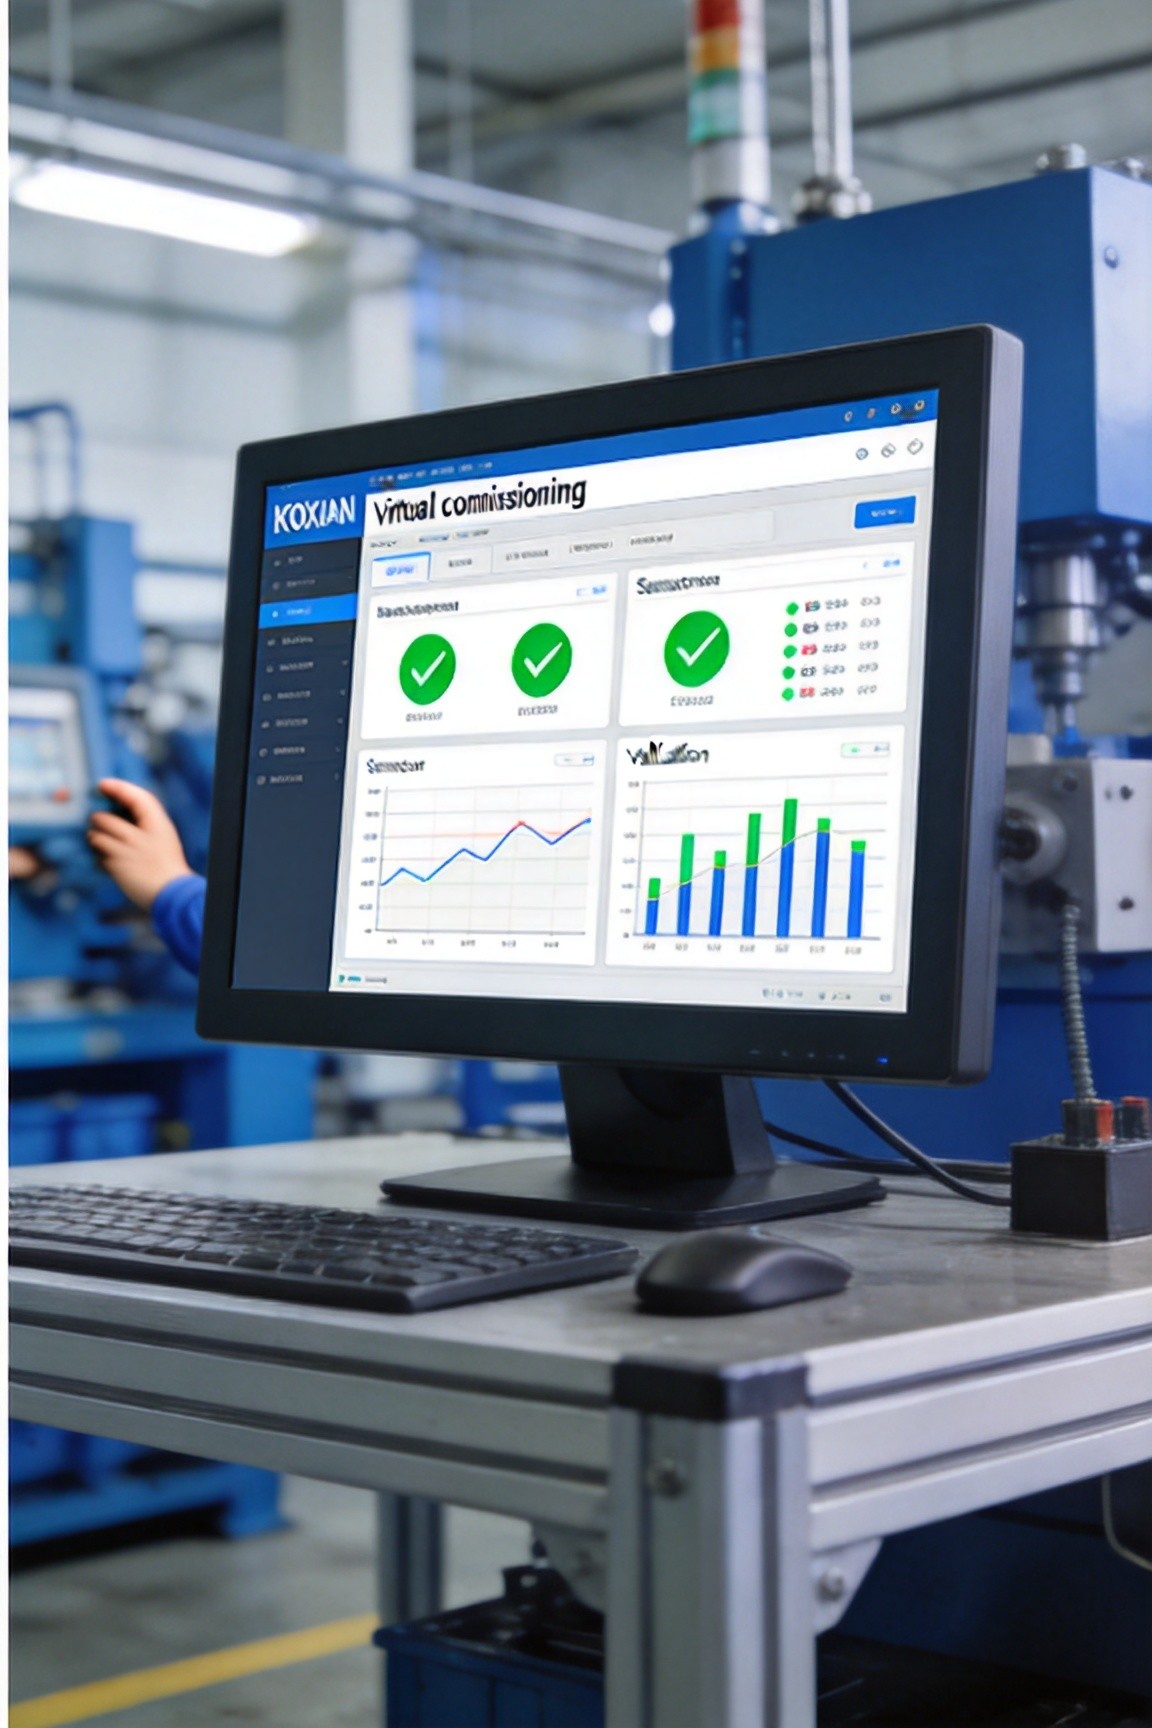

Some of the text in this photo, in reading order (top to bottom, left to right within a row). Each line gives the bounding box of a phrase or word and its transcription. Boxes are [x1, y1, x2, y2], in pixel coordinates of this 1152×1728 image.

[273, 494, 356, 534] KOXIAN
[374, 477, 587, 526] Virtual commissioning
